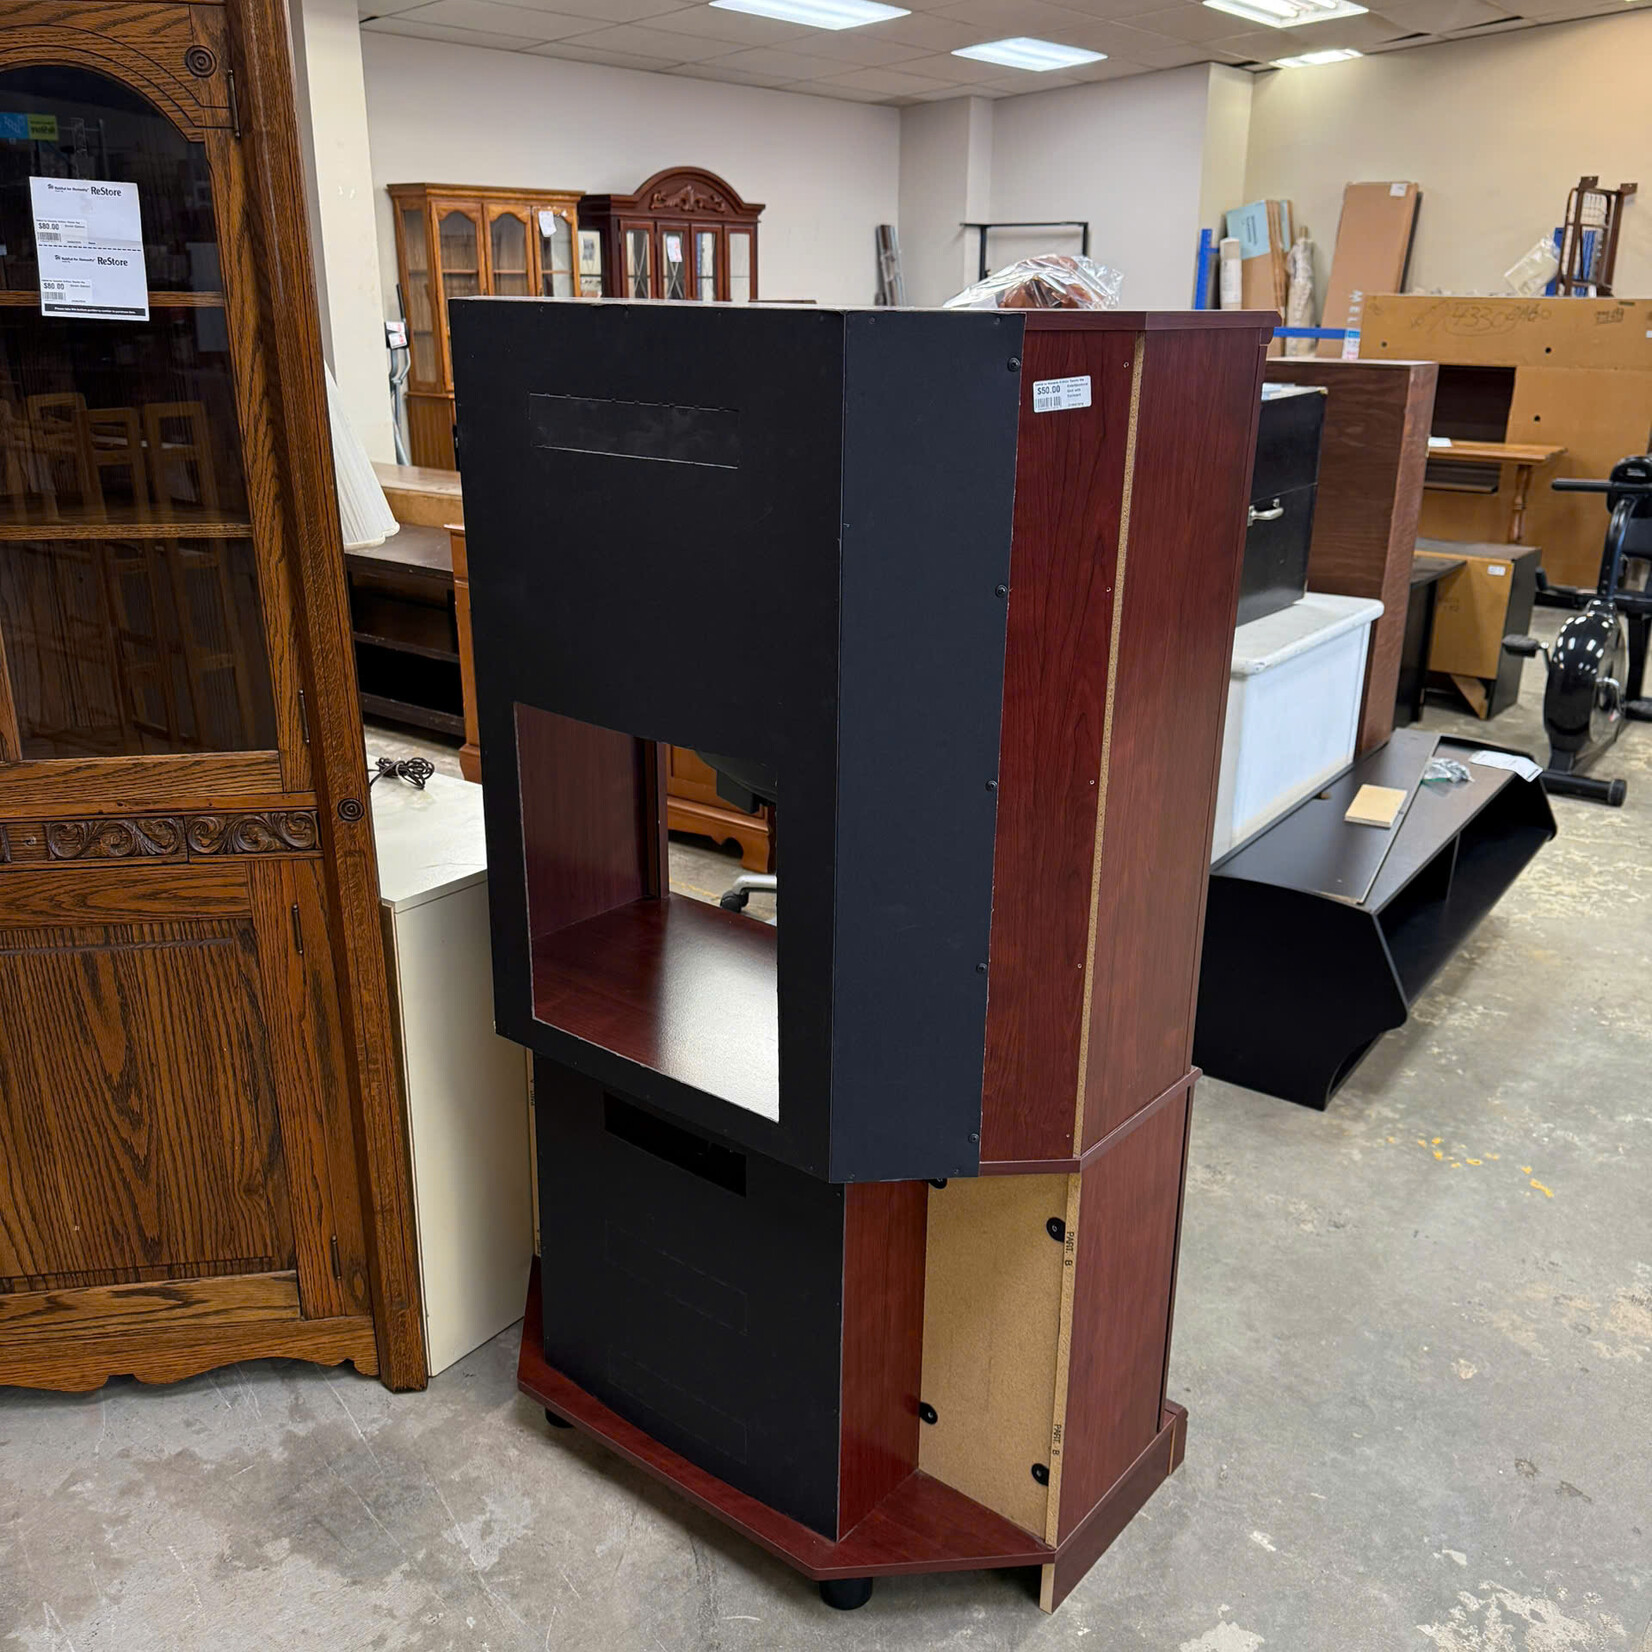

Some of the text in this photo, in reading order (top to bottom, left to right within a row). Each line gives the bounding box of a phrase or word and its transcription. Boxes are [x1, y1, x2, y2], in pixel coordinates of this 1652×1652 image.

[90, 186, 122, 197] ReStore
[38, 222, 60, 231] $80.00
[97, 256, 129, 267] ReStore
[1037, 385, 1061, 395] $50.00
